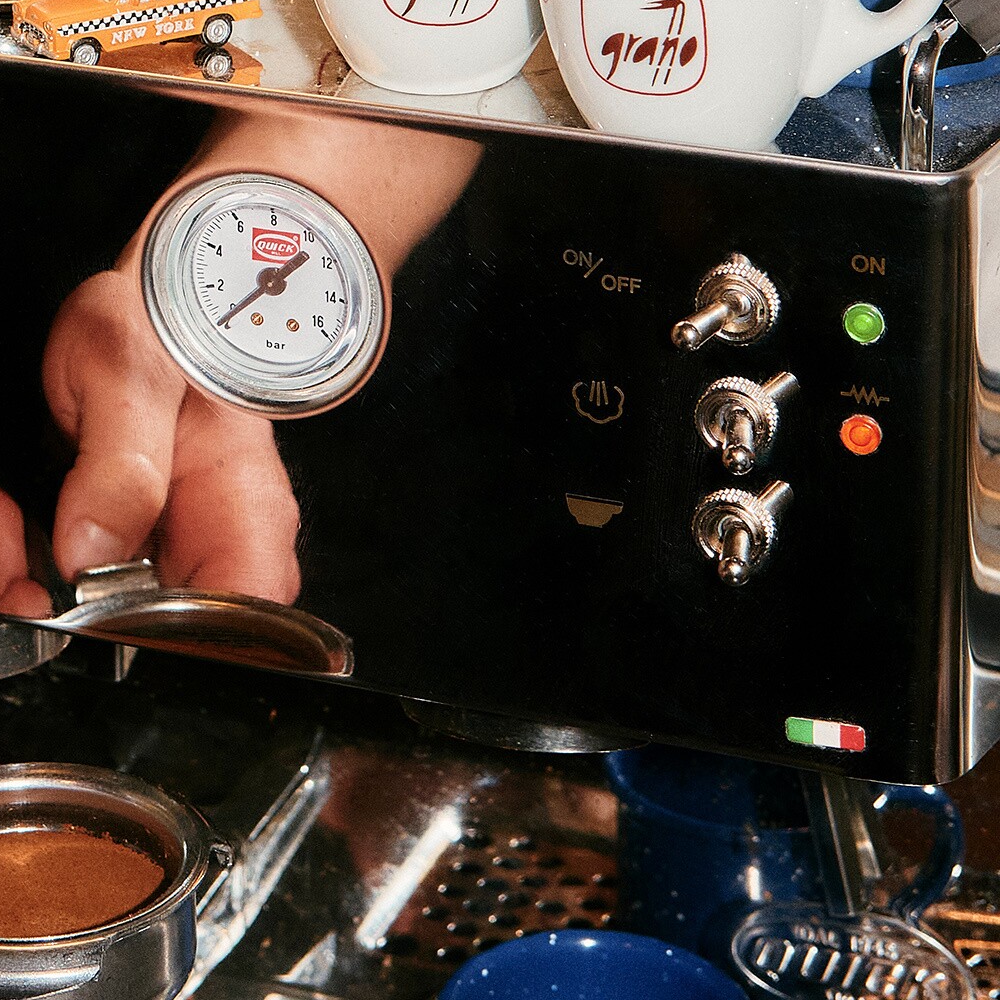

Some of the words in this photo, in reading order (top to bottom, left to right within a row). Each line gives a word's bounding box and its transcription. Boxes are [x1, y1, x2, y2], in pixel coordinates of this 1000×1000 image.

[110, 25, 148, 46] NEW
[154, 16, 196, 36] YORK
[600, 31, 699, 87] grano
[236, 220, 245, 233] 6
[270, 215, 278, 227] 8
[303, 230, 315, 243] 10
[215, 245, 224, 258] 4
[257, 240, 295, 254] QUICK
[321, 256, 334, 270] 12
[851, 254, 886, 276] ON
[217, 279, 225, 292] 2
[324, 291, 337, 304] 14
[312, 315, 324, 329] 16
[265, 339, 286, 351] bar
